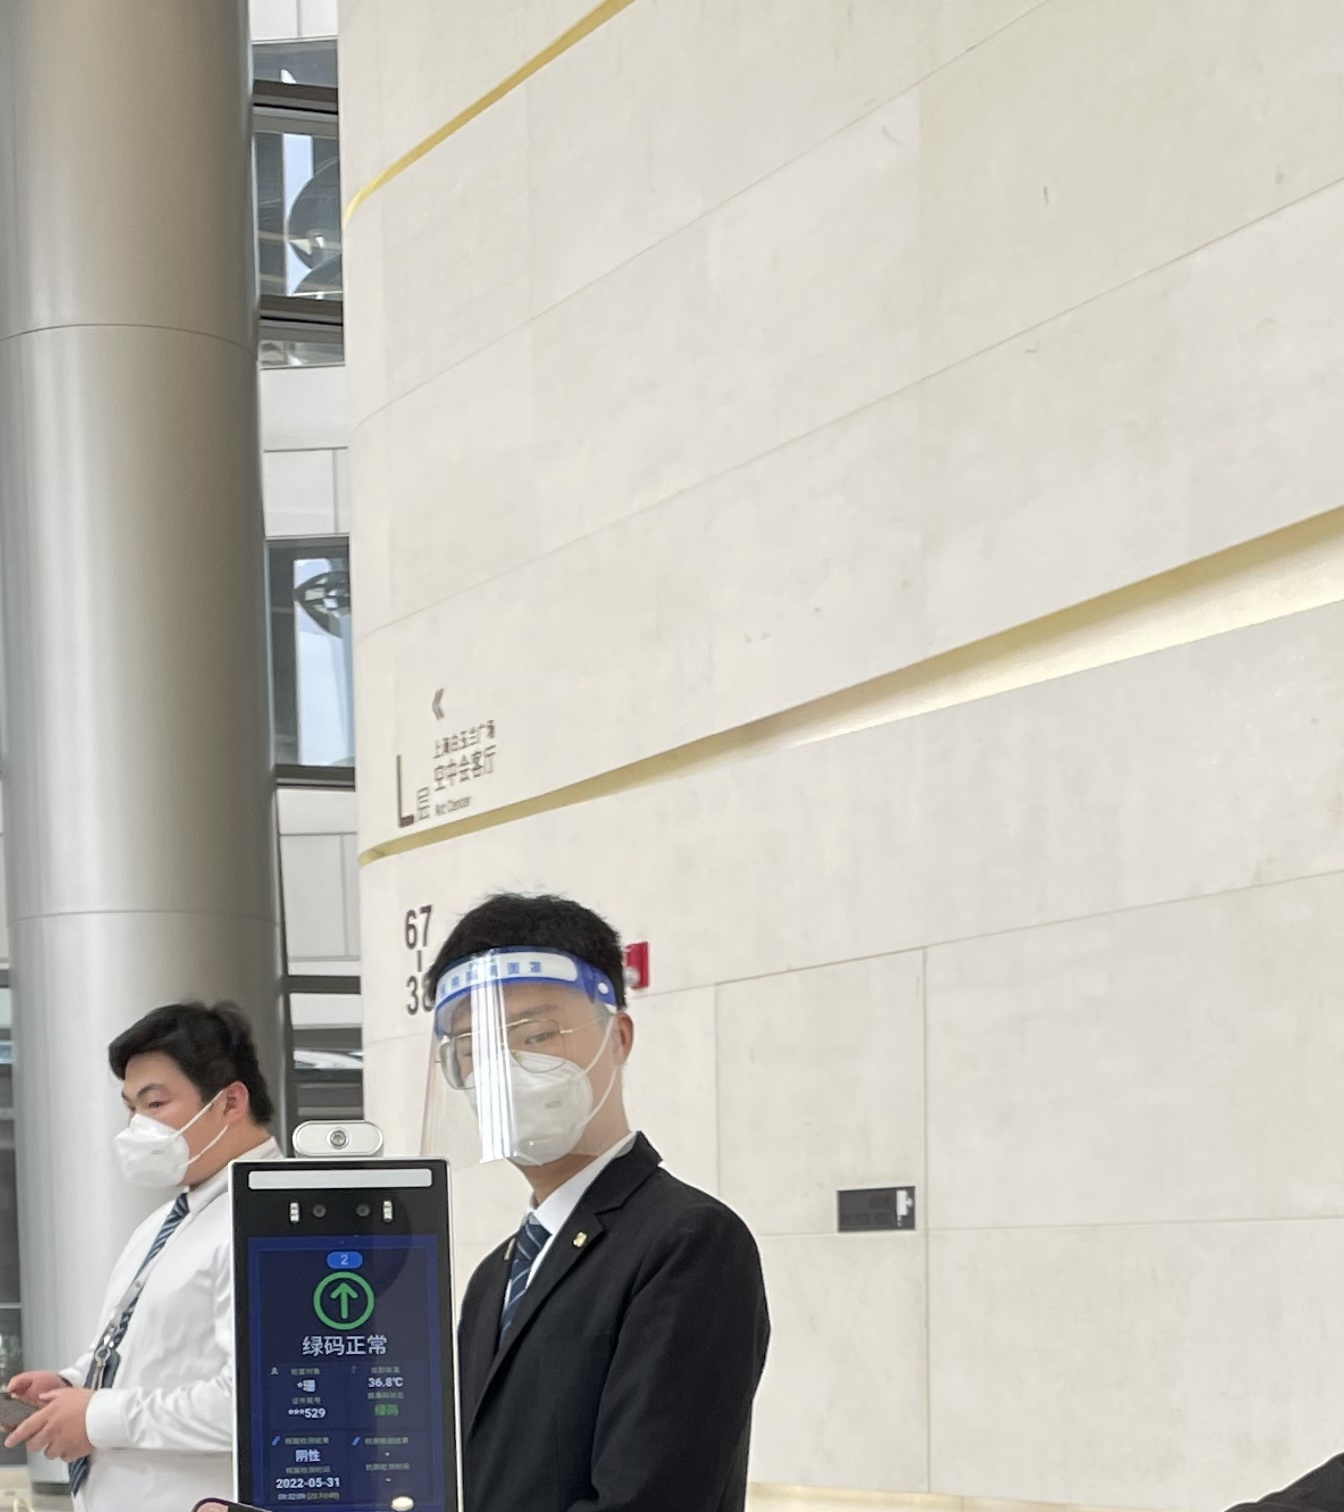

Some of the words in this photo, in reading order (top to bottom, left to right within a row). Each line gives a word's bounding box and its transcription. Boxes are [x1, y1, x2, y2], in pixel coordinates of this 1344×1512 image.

[405, 904, 432, 949] 67
[340, 1254, 349, 1266] 2
[302, 1334, 387, 1357] 绿码正常
[295, 1449, 321, 1463] 阴性
[276, 1477, 340, 1489] 2022-05-31
